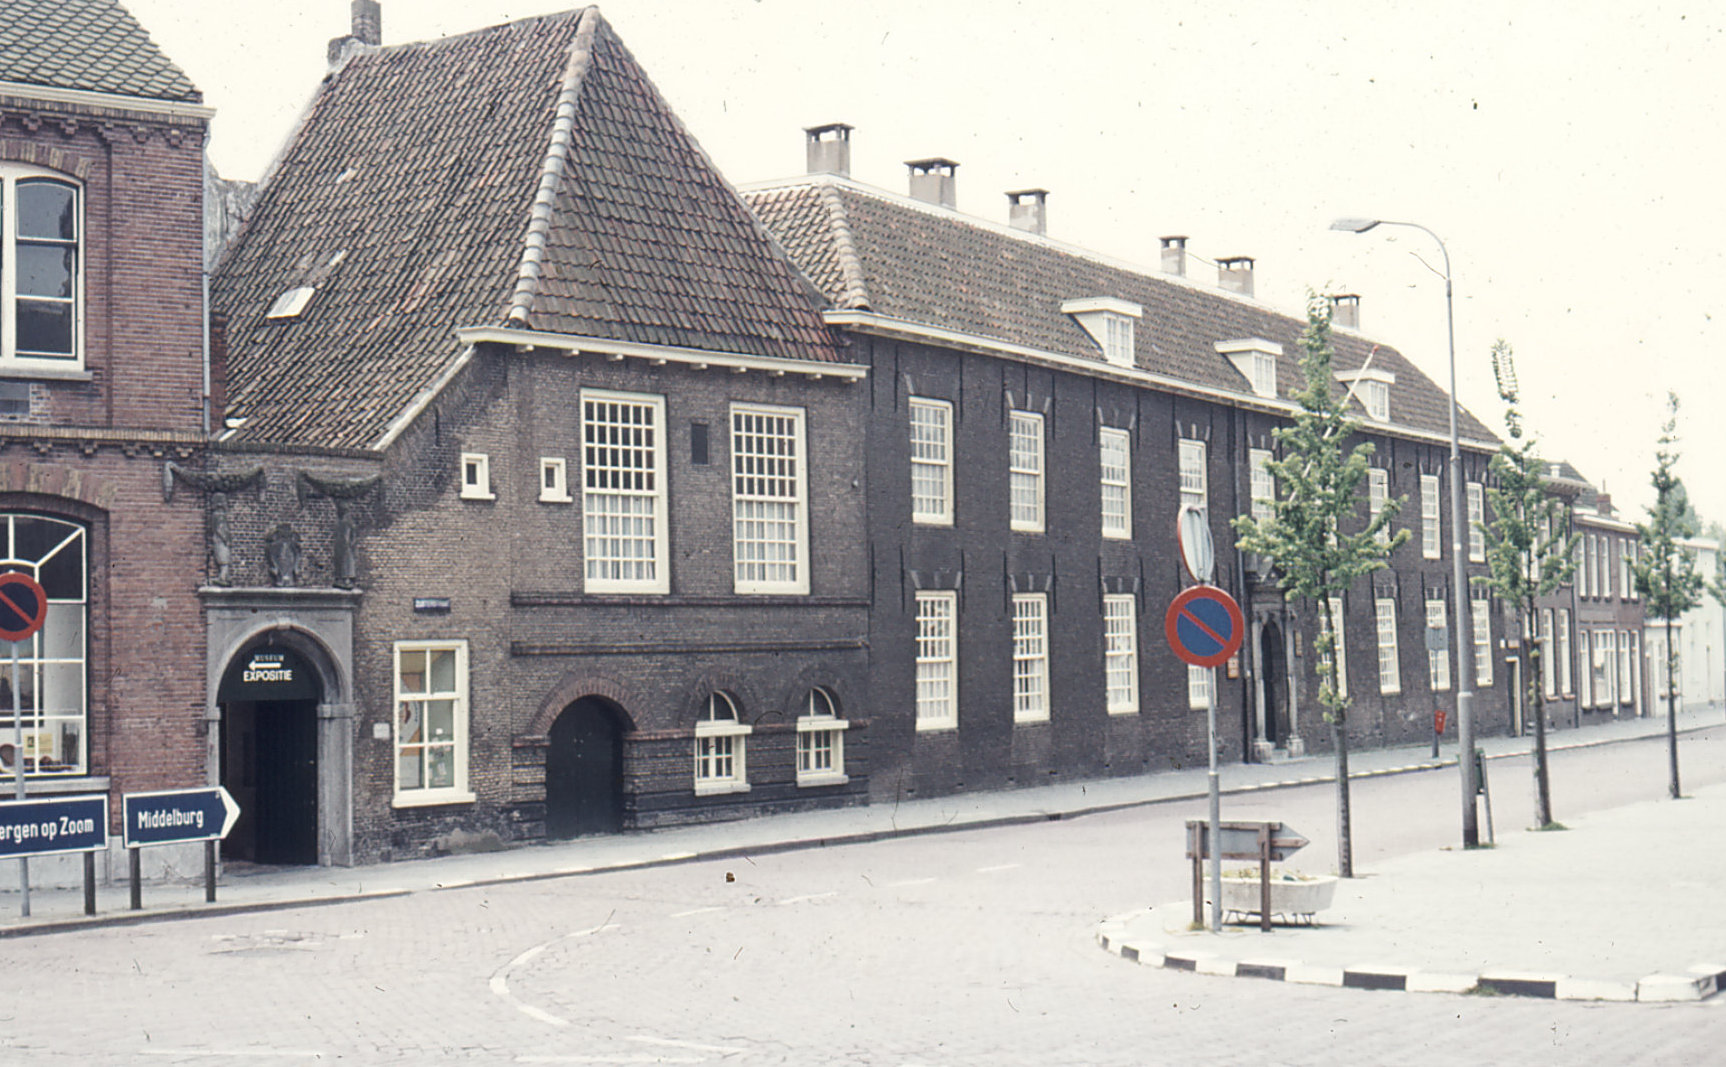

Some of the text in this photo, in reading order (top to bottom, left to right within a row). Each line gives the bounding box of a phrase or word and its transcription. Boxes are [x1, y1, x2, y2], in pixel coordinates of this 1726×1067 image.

[243, 669, 293, 682] EXPOSITIE
[41, 822, 57, 841] op
[60, 816, 94, 836] Zoom
[138, 808, 204, 829] Middelburg
